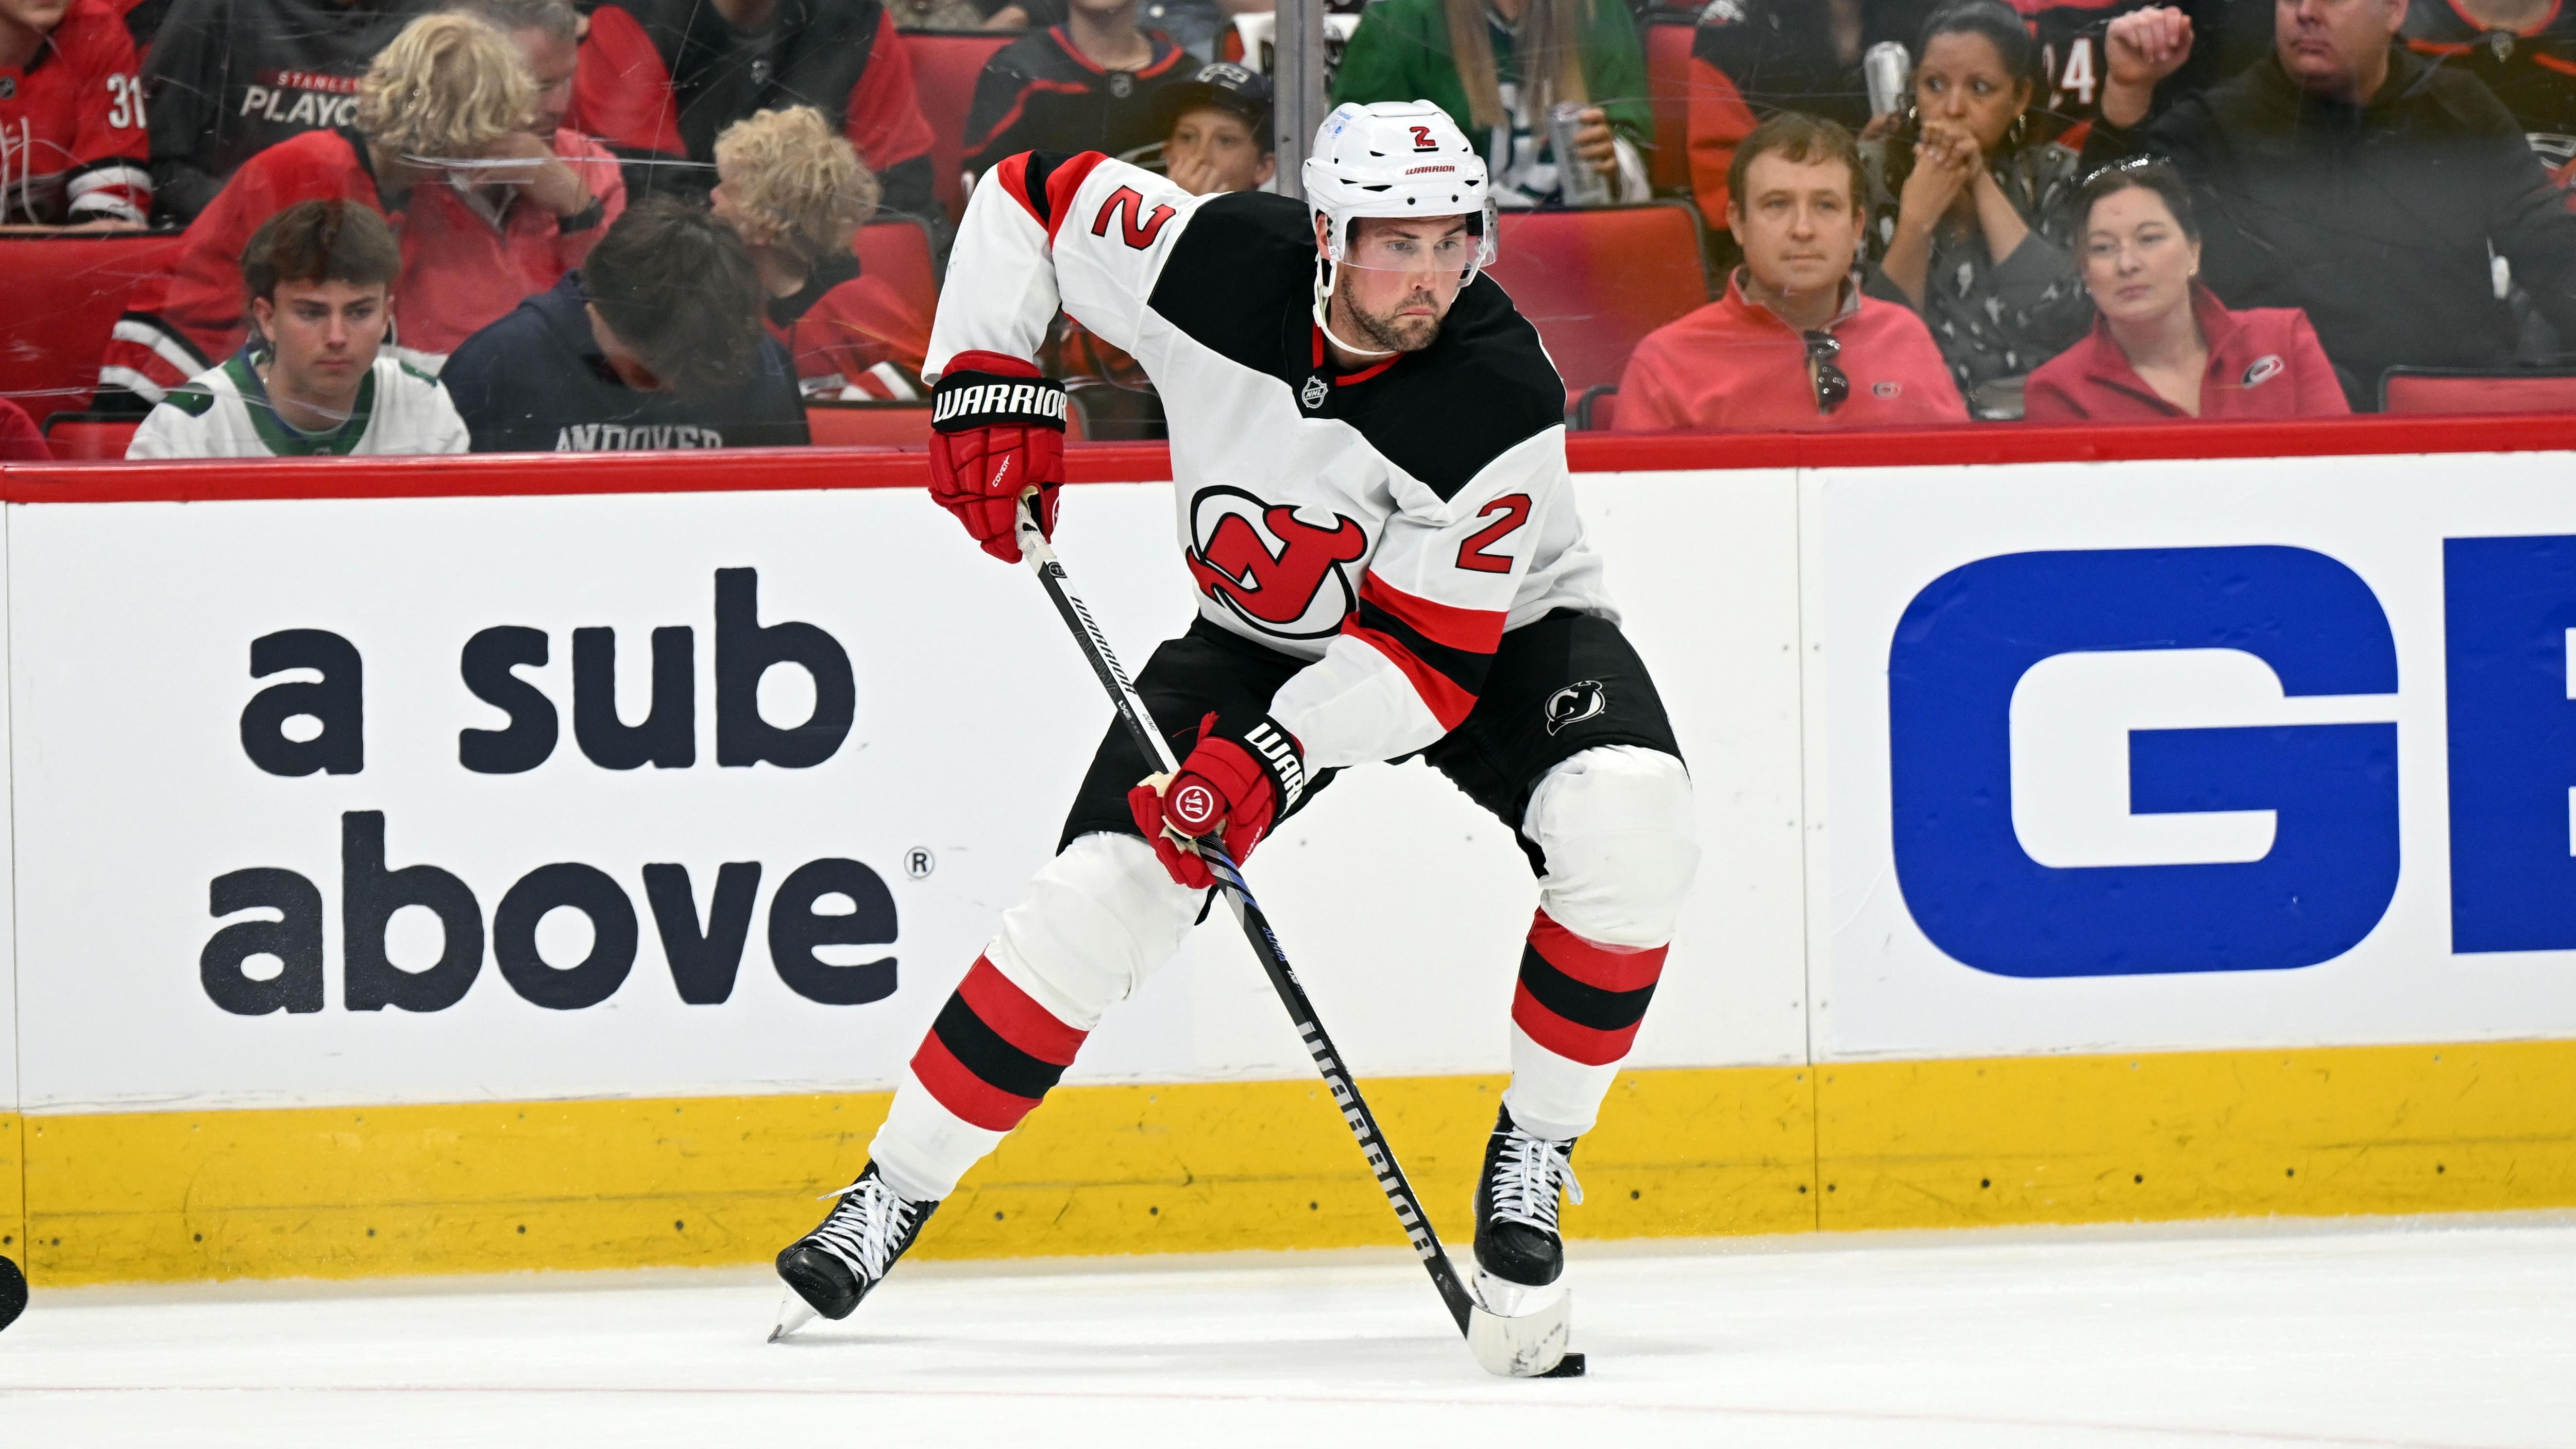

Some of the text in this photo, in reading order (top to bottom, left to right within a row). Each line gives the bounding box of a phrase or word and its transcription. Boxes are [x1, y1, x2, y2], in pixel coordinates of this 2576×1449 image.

[107, 72, 146, 129] 31
[1410, 126, 1436, 147] 2
[1405, 165, 1455, 175] WARRIOR
[1091, 185, 1176, 250] 2
[933, 384, 1068, 423] WARRIOR
[1305, 388, 1322, 399] NHL
[1455, 493, 1533, 574] 2
[240, 567, 856, 777] a sub
[1070, 596, 1137, 695] WARRIOR
[1073, 630, 1118, 702] ALPHA
[1142, 713, 1157, 732] DUMO
[200, 810, 898, 1016] above
[1297, 1020, 1436, 1260] WARRIOR
